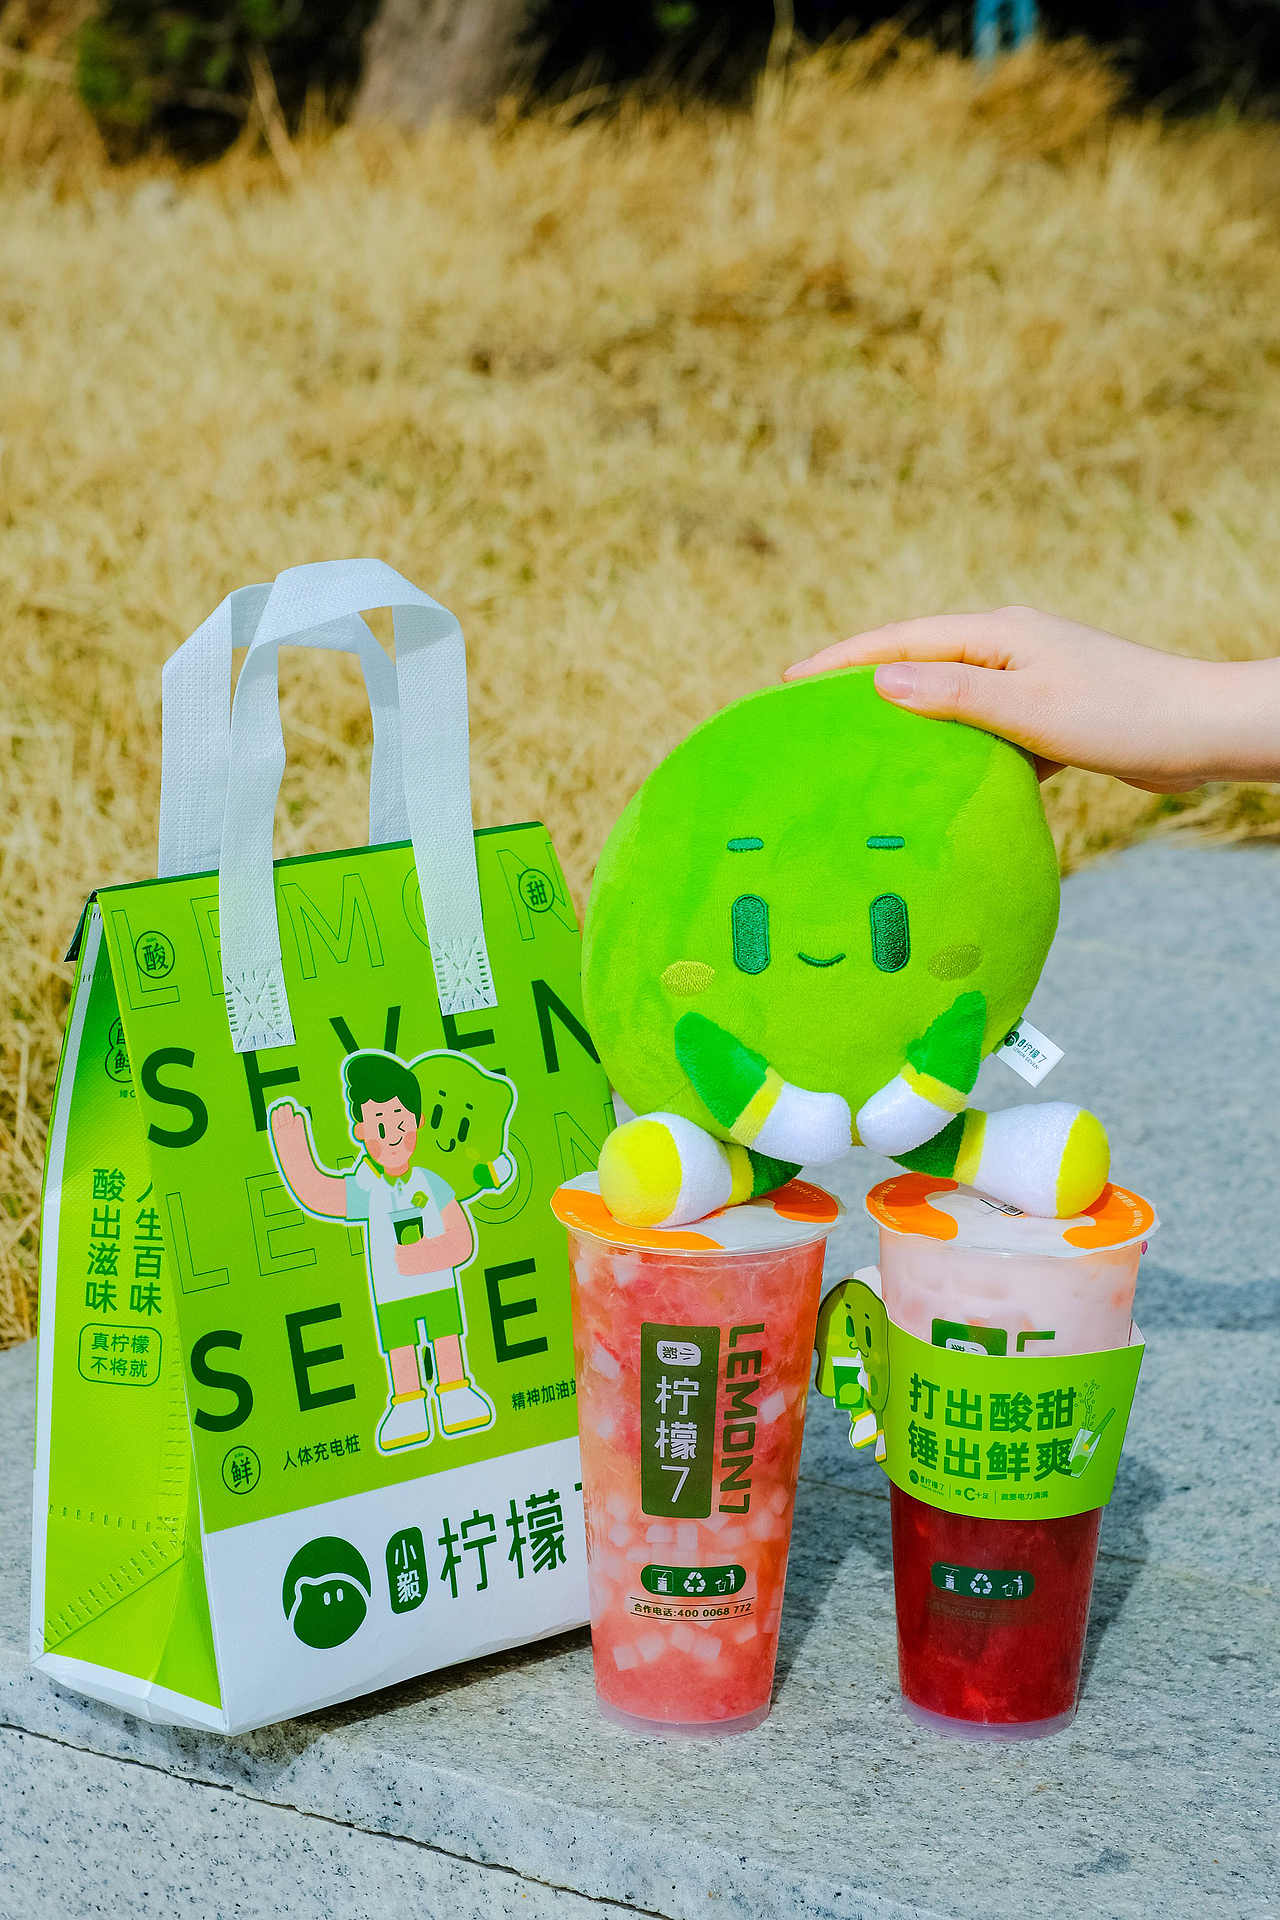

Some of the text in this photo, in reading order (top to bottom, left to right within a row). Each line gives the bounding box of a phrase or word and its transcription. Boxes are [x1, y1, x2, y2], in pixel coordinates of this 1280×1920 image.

[526, 879, 548, 906] 甜
[142, 942, 168, 971] 酸
[85, 1168, 126, 1314] 酸出滋味
[91, 1332, 149, 1354] 真柠檬
[90, 1356, 148, 1378] 不将就
[718, 1323, 766, 1514] LEMON7
[909, 1372, 1077, 1434] 打出酸甜
[283, 1434, 361, 1471] 人体充电桩
[654, 1375, 700, 1503] 柠檬7
[907, 1420, 1073, 1482] 锤出鲜爽
[231, 1456, 253, 1488] 鲜
[437, 1481, 582, 1599] 柠檬
[702, 1607, 730, 1617] 0068
[733, 1603, 751, 1614] 772
